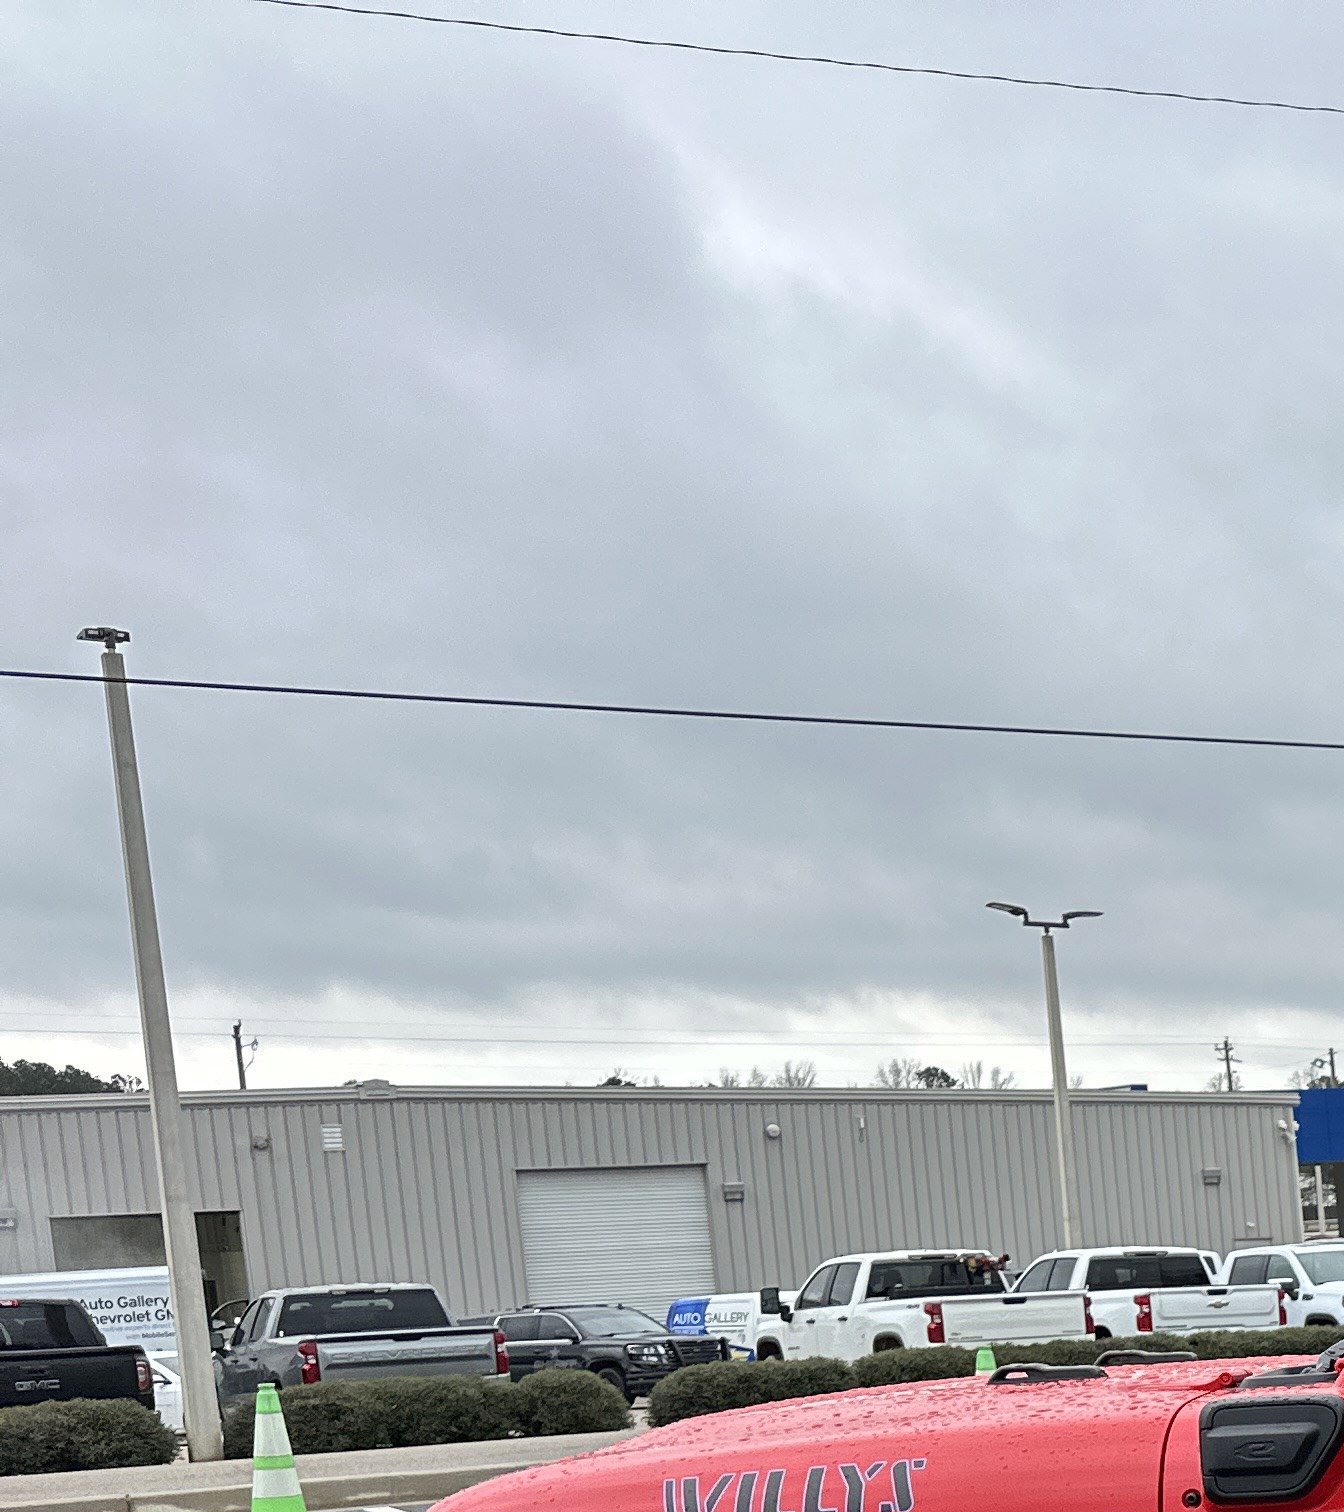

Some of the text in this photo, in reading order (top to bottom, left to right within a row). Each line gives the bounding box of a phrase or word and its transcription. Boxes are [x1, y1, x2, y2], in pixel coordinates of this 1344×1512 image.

[117, 1295, 169, 1308] Gallery
[90, 1310, 151, 1324] hevrolet
[673, 1311, 749, 1325] AUTO GALLERY
[15, 1379, 60, 1391] GMC
